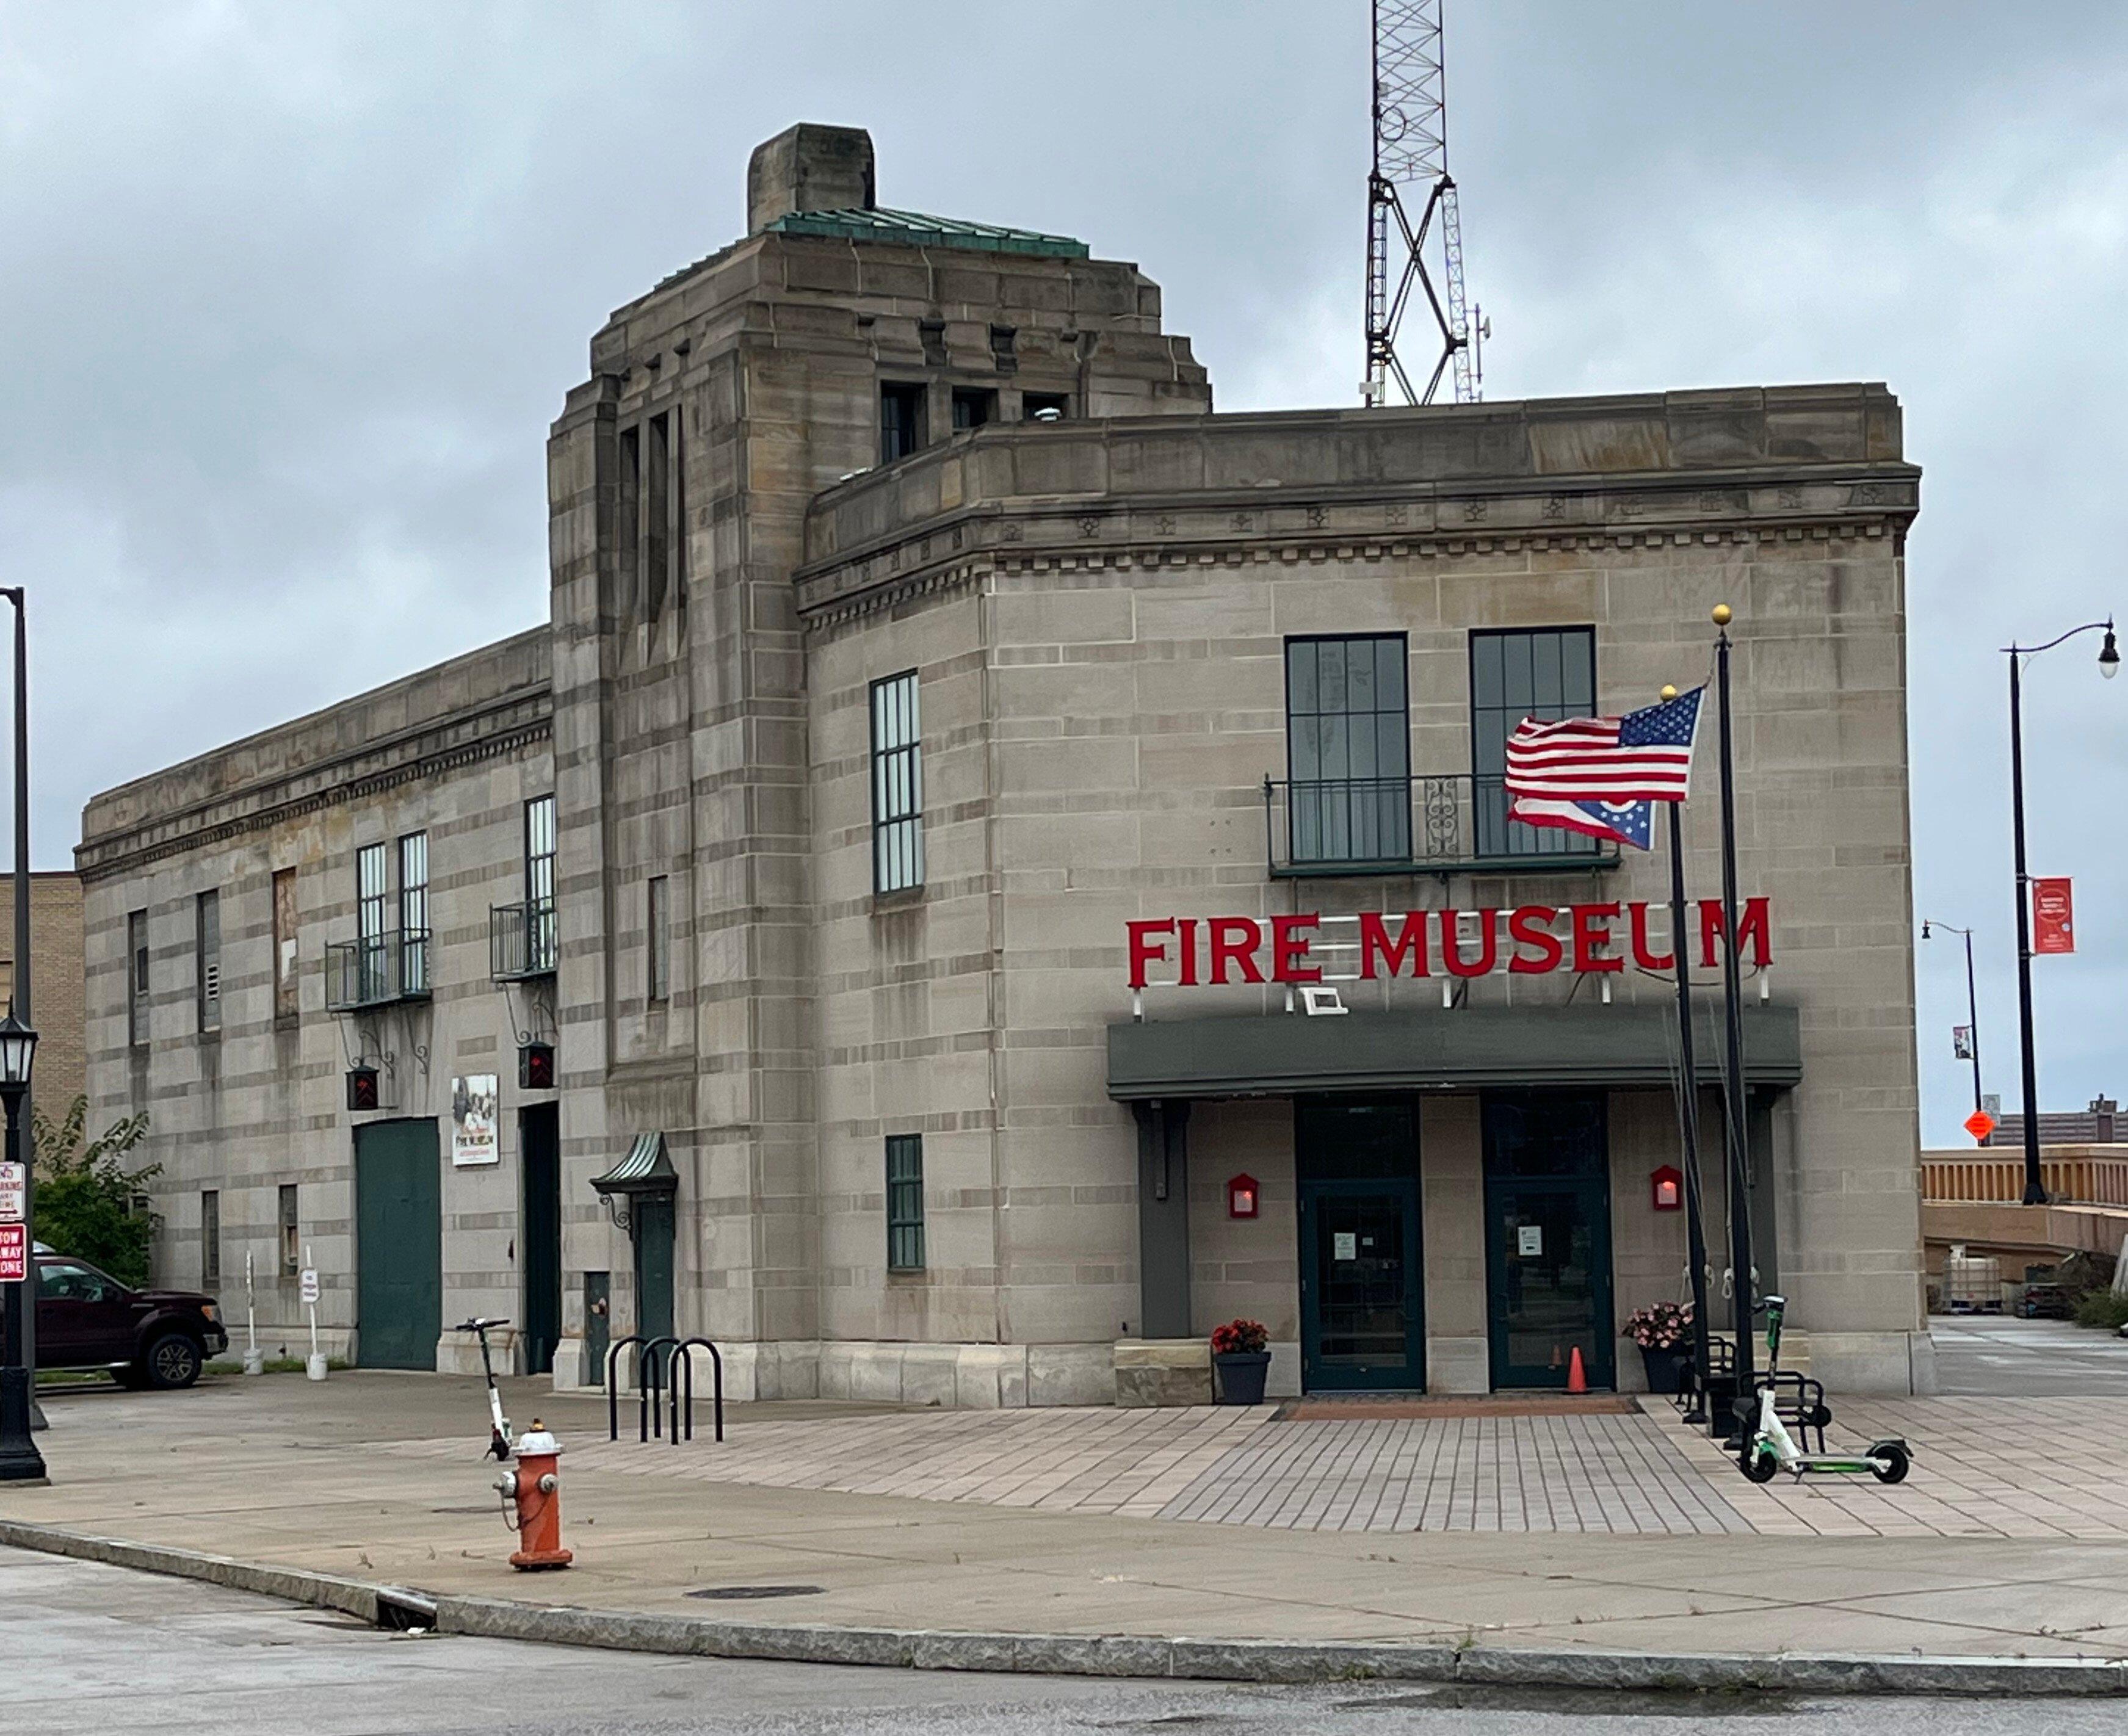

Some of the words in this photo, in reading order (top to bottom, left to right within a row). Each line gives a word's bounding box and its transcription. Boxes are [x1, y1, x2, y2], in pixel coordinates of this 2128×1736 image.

[1126, 910, 1322, 988] FIRE
[1358, 897, 1773, 979] MUSEUM
[0, 1246, 23, 1259] WAY
[0, 1260, 23, 1274] ONE
